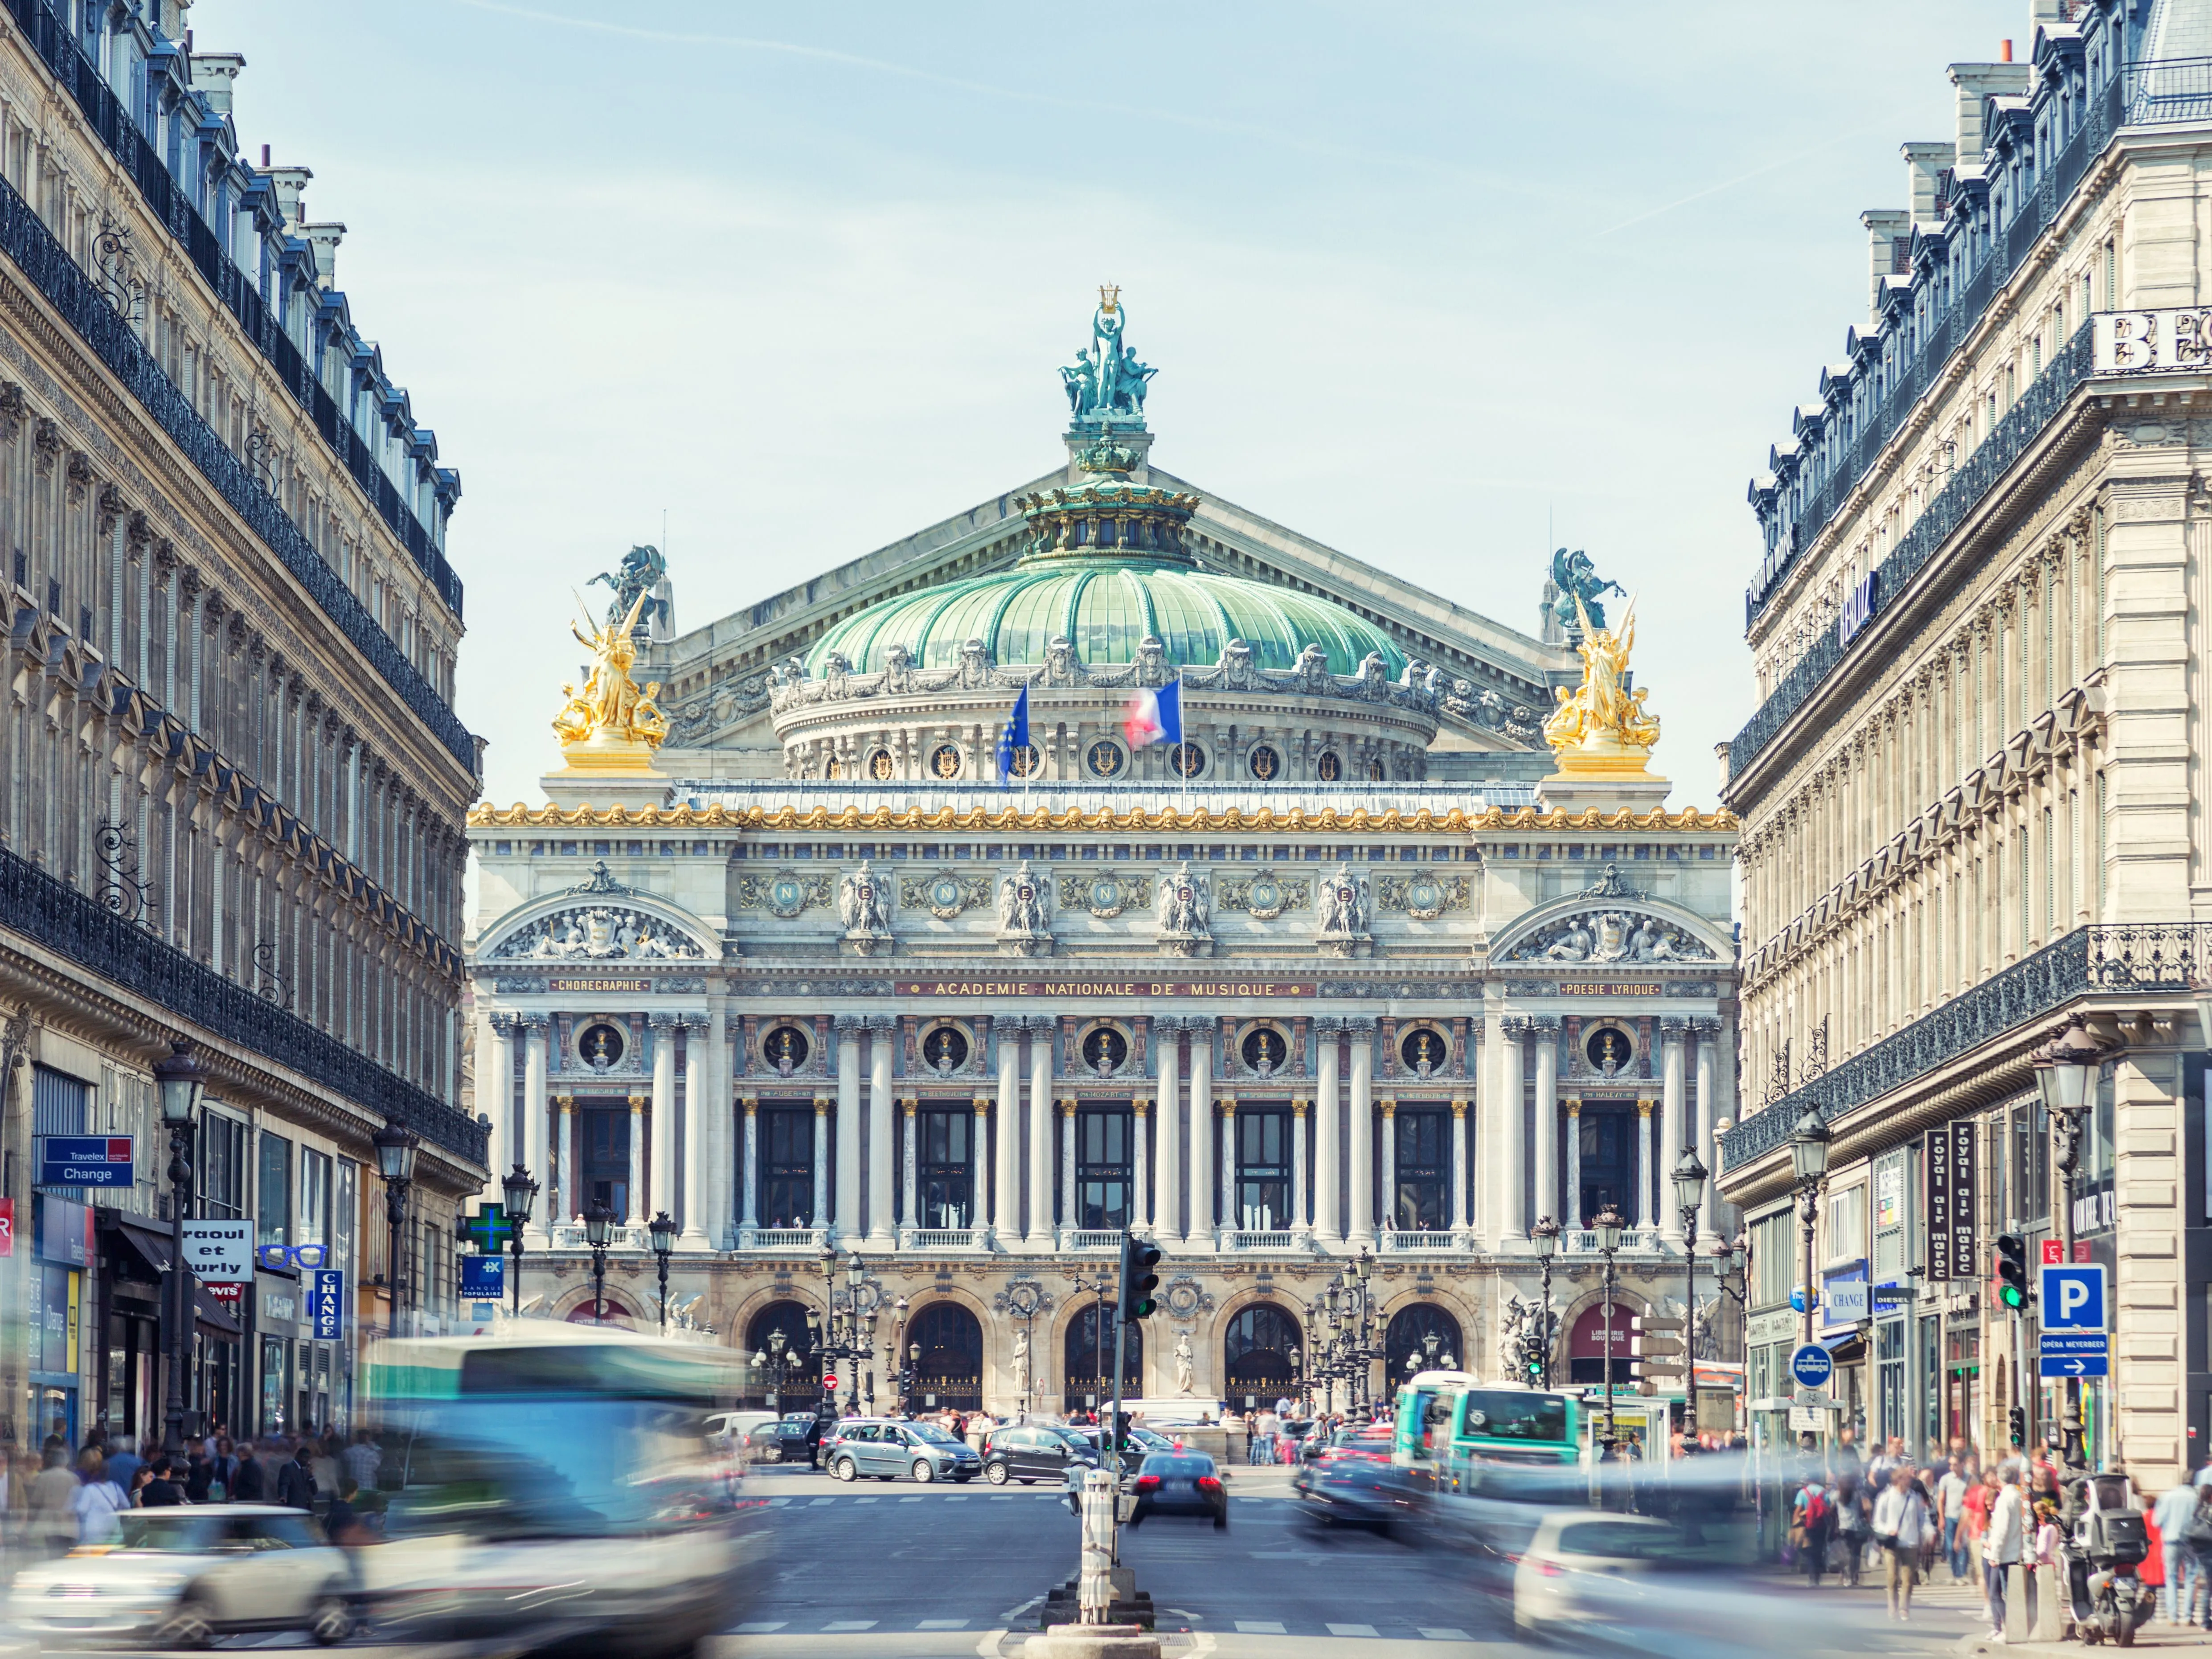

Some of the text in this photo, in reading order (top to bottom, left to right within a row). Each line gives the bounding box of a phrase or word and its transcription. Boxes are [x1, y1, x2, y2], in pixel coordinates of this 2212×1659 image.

[2093, 309, 2212, 371] BE
[1840, 571, 1874, 647] BERLITZ
[782, 887, 791, 898] N
[862, 889, 869, 898] E
[942, 888, 950, 899] N
[1021, 889, 1029, 898] E
[1101, 888, 1110, 899] N
[1181, 890, 1189, 900] E
[1260, 889, 1270, 901] N
[1341, 890, 1348, 900] E
[1419, 889, 1429, 901] N
[558, 980, 641, 991] CHOREGRAPHIE
[935, 983, 1275, 996] ACADEMIE NATIONALE DE MUSIQUE
[1566, 984, 1655, 995] POESIE LYRIQUE
[70, 1152, 104, 1160] Travelex
[64, 1168, 112, 1182] Change
[1956, 1127, 1972, 1272] royal air maroc
[1931, 1136, 1947, 1278] royal air maroc
[183, 1229, 244, 1239] raoul
[199, 1246, 225, 1255] et
[190, 1262, 241, 1274] urly
[208, 1286, 238, 1295] evi's
[1834, 1294, 1864, 1307] CHANGE
[2060, 1279, 2089, 1319] P
[321, 1274, 336, 1336] CHANGE
[2042, 1340, 2064, 1348] OPÉRA
